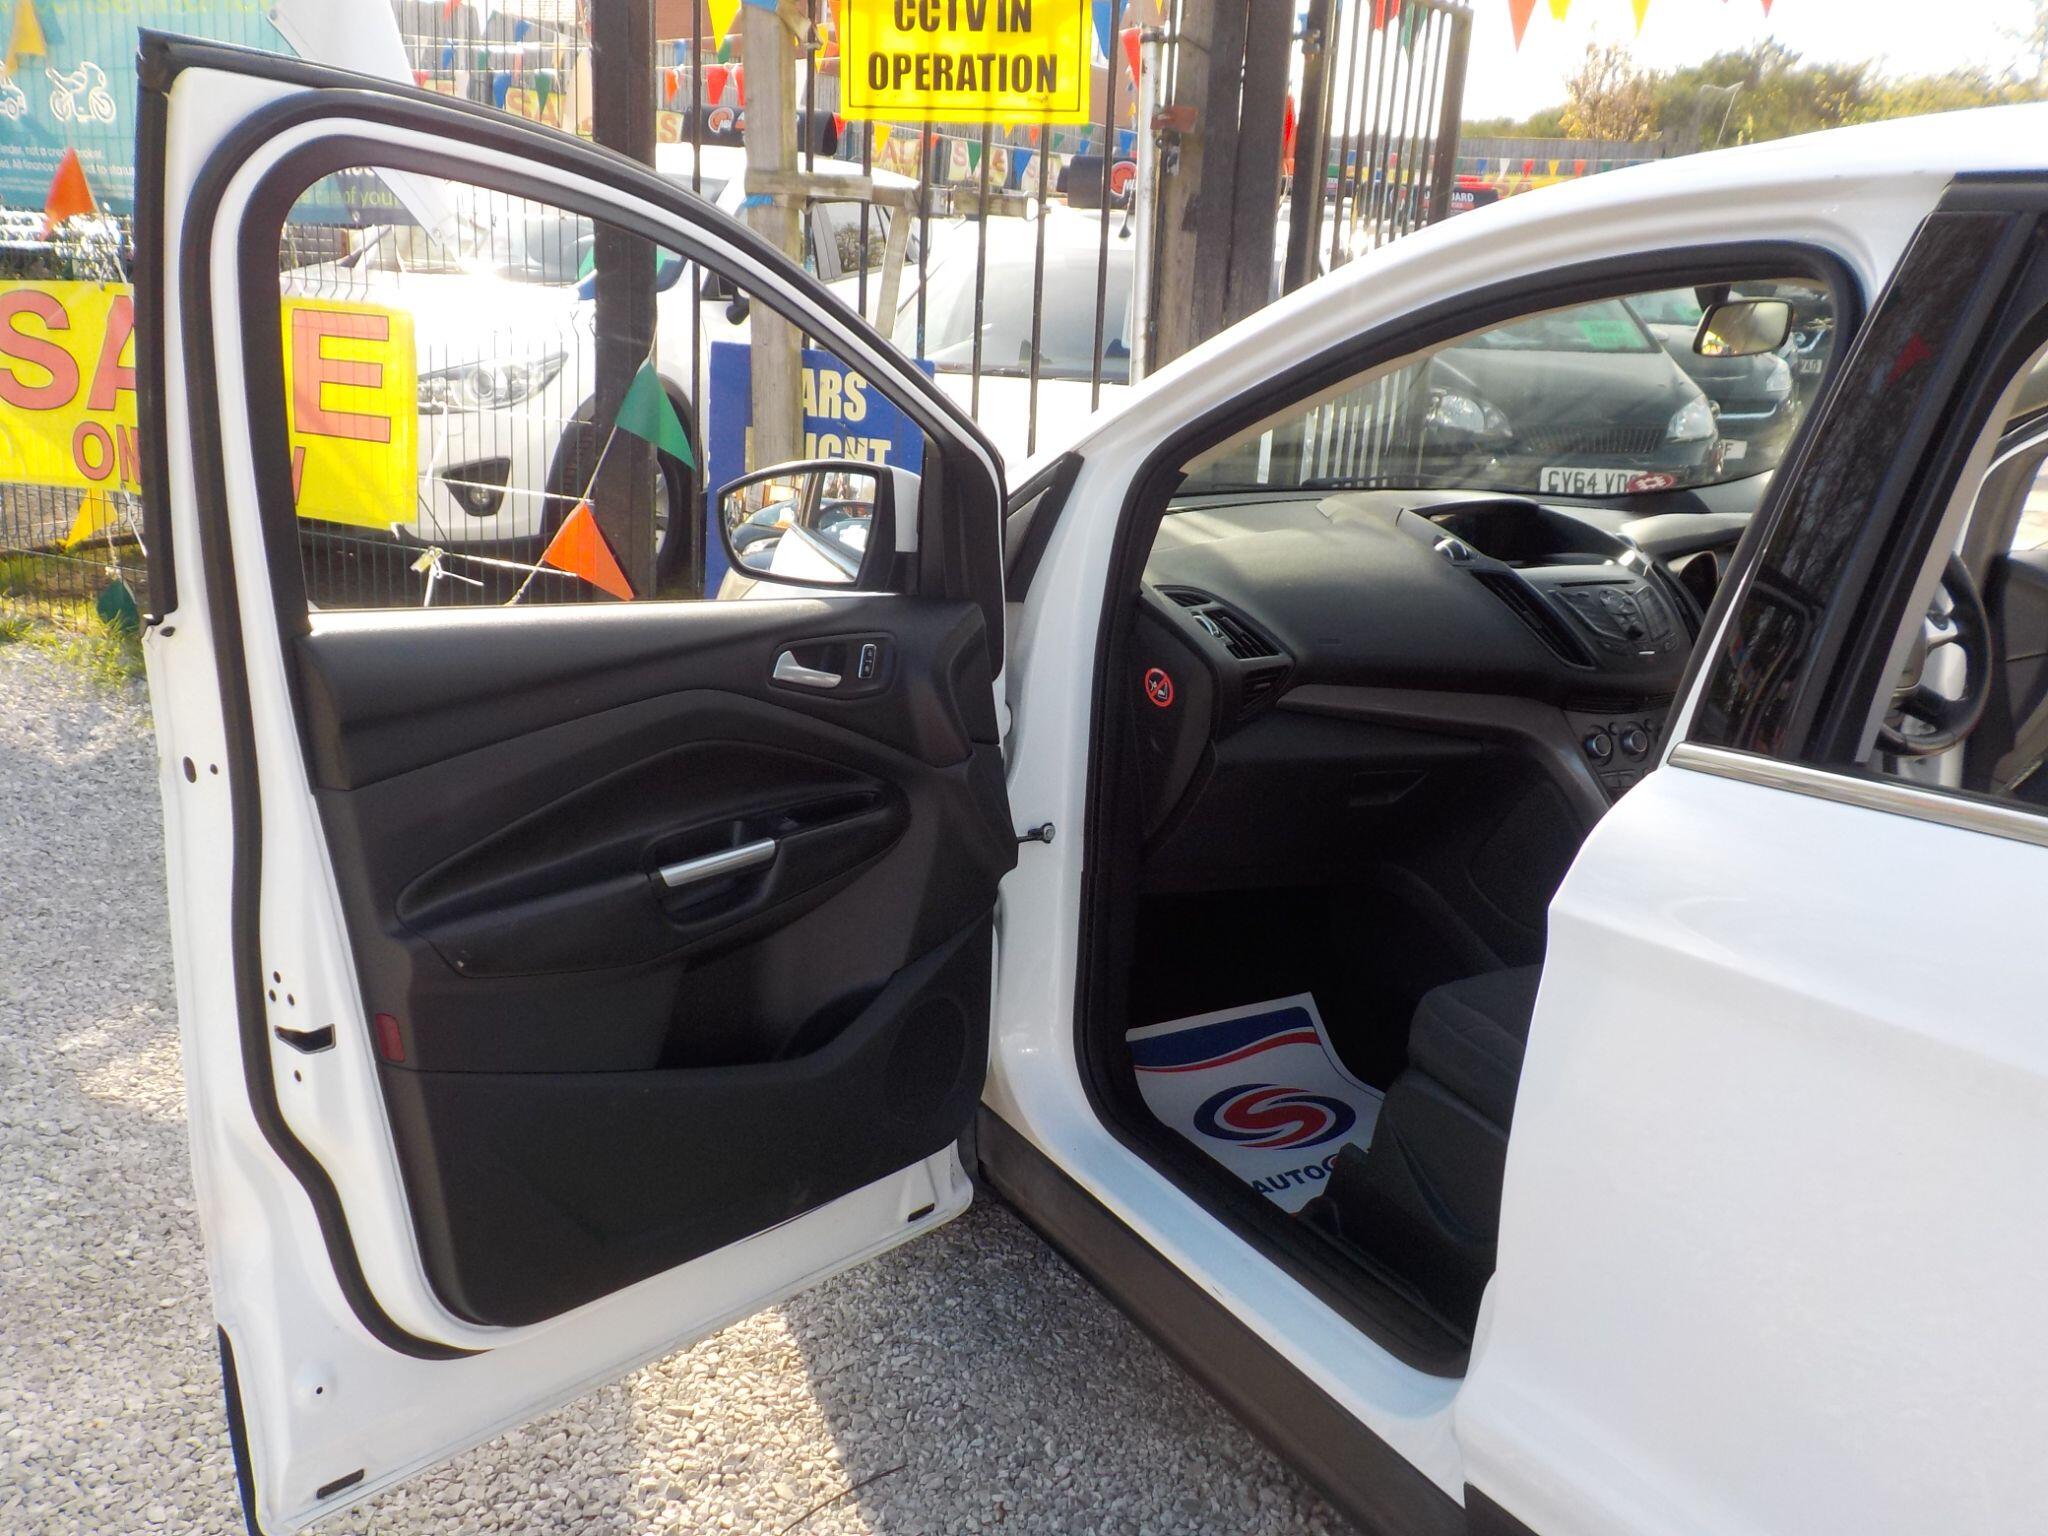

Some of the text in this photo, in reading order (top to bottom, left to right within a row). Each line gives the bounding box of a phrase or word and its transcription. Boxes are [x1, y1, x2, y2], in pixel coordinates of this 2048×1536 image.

[894, 0, 1032, 32] CCTV IN
[868, 51, 1057, 93] OPERATION
[0, 289, 392, 443] SAE
[801, 367, 868, 422] ARS
